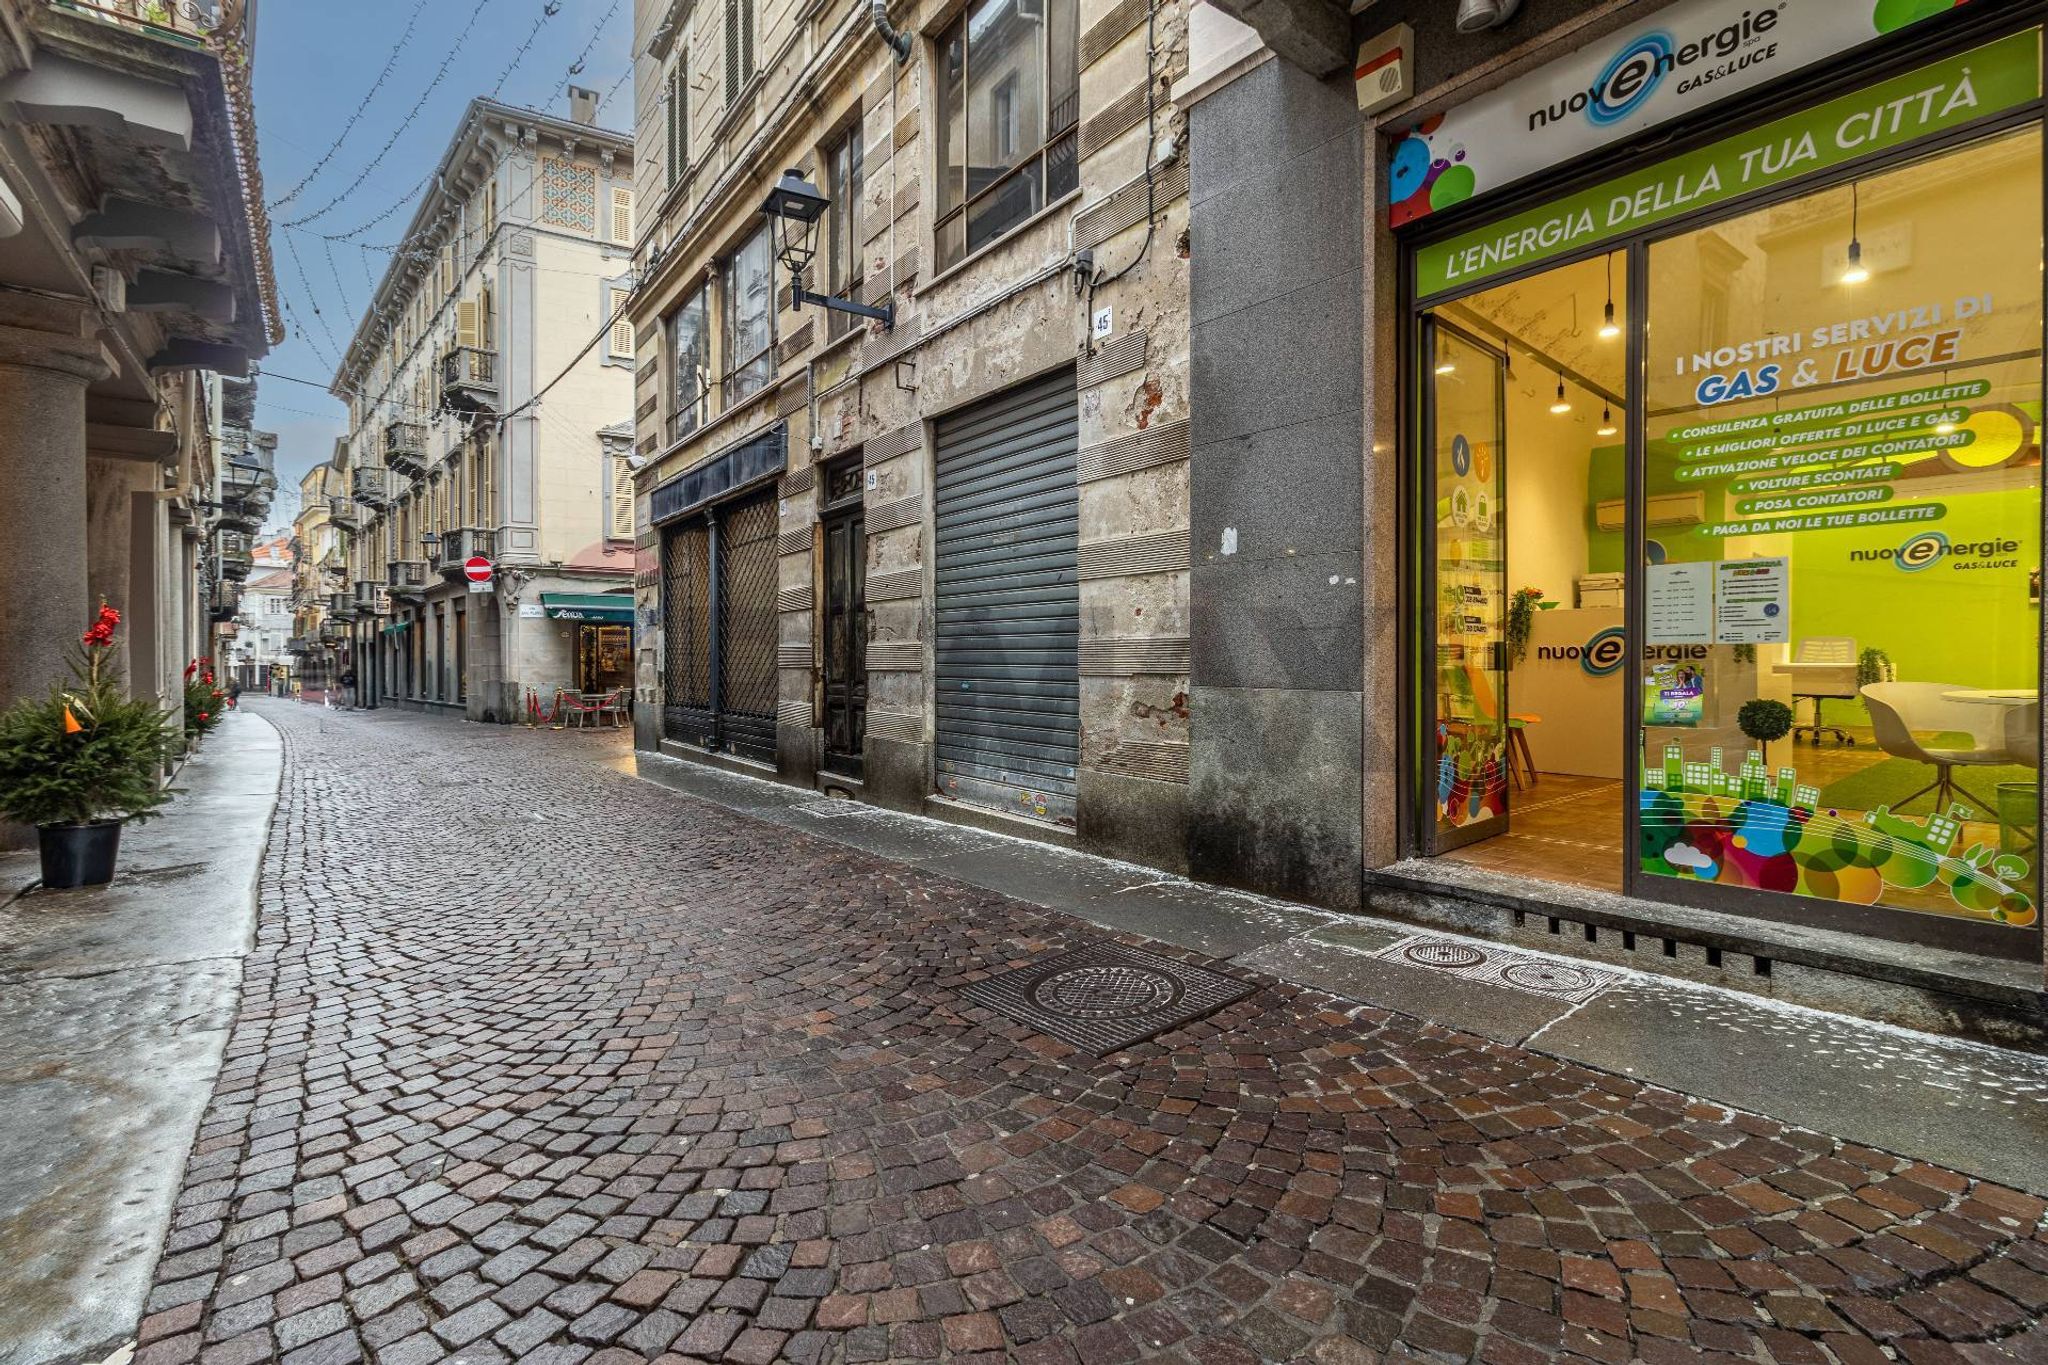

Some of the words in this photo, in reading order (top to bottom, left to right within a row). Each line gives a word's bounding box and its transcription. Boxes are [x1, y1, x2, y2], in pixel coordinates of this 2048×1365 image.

[1677, 43, 1778, 95] GAS&LUCE
[1446, 207, 1595, 280] L'ENERGIA
[1606, 163, 1722, 228] DELLA
[1738, 130, 1818, 183] TUA
[1835, 66, 1979, 149] CITTÀ
[1097, 314, 1109, 332] 45
[1676, 356, 1684, 376] I
[1691, 332, 1802, 374] NOSTRI
[1811, 302, 1943, 349] SERVIZI
[1954, 292, 1994, 320] DI
[1696, 363, 1781, 406] GAS
[1792, 358, 1819, 388] &
[1834, 328, 1964, 382] LUCE
[1681, 416, 1769, 440] CONSULENZA
[1772, 405, 1844, 425] GRATUITA
[1848, 396, 1895, 414] DELLE
[1900, 382, 1982, 406] BOLLETTE
[1695, 446, 1711, 457] LE
[1713, 435, 1777, 455] MIGLIORI
[1780, 426, 1841, 445] OFFERTE
[1845, 423, 1862, 436] DI
[1866, 417, 1906, 434] LUCE
[1910, 416, 1921, 428] E
[1925, 409, 1961, 426] GAS
[1691, 457, 1778, 478] ATTIVAZIONE
[1781, 449, 1839, 467] VELOCE
[1842, 446, 1867, 459] DEI
[1871, 432, 1967, 455] CONTATORI
[1749, 474, 1810, 492] VOLTURE
[1814, 465, 1892, 485] SCONTATE
[1712, 523, 1747, 536] PAGA
[1752, 521, 1770, 533] DA
[1775, 518, 1802, 531] NOI
[1805, 517, 1821, 528] LE
[1826, 513, 1854, 526] TUE
[1857, 505, 1937, 523] BOLLETTE
[1754, 499, 1792, 511] POSA
[1796, 488, 1884, 507] CONTATORI
[1953, 560, 2019, 570] GAS&LUCE
